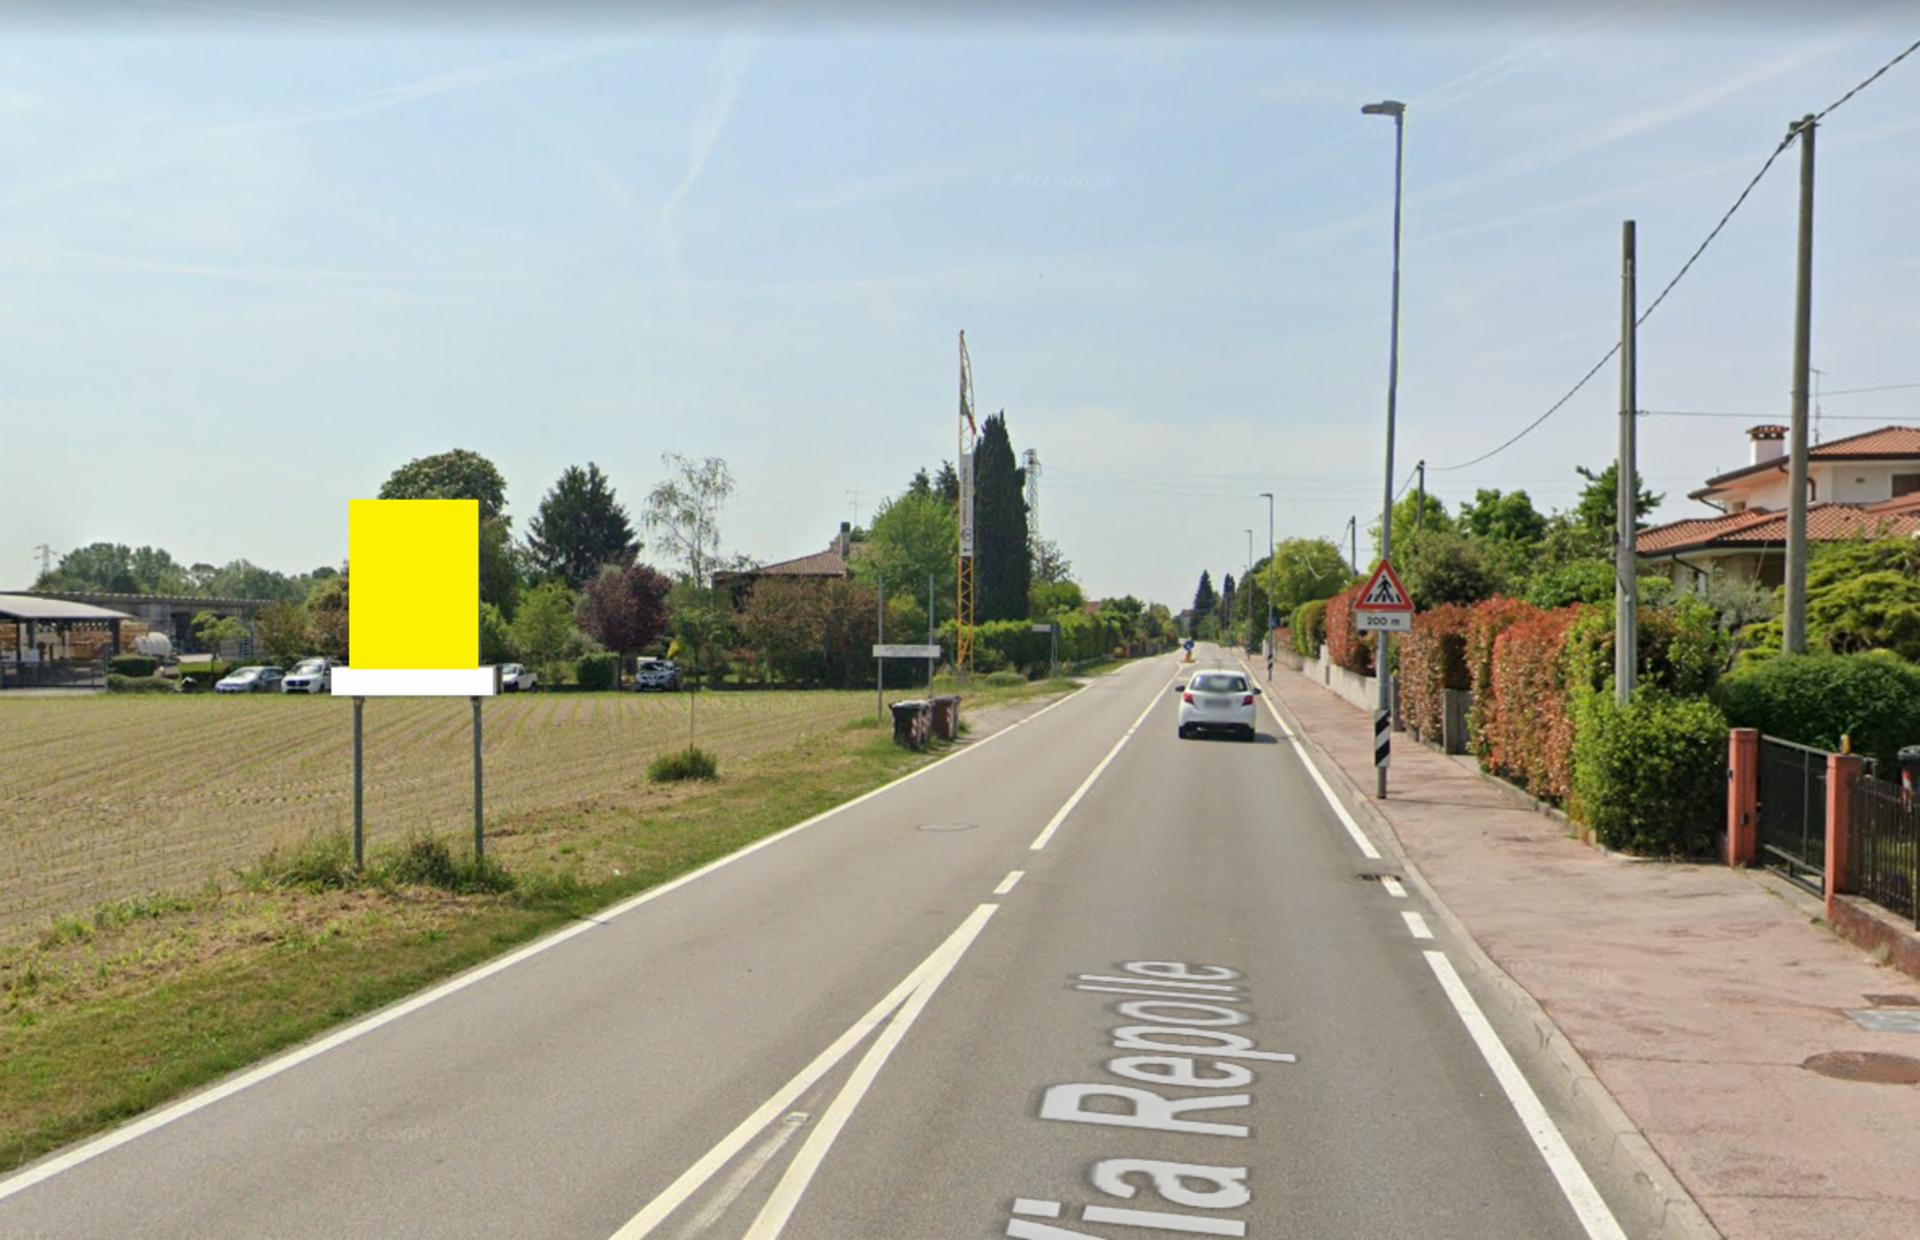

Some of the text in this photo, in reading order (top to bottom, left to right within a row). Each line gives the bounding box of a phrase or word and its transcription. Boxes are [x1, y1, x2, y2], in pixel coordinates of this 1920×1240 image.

[1366, 616, 1401, 626] 200 m
[1005, 961, 1297, 1240] ia Repolle
